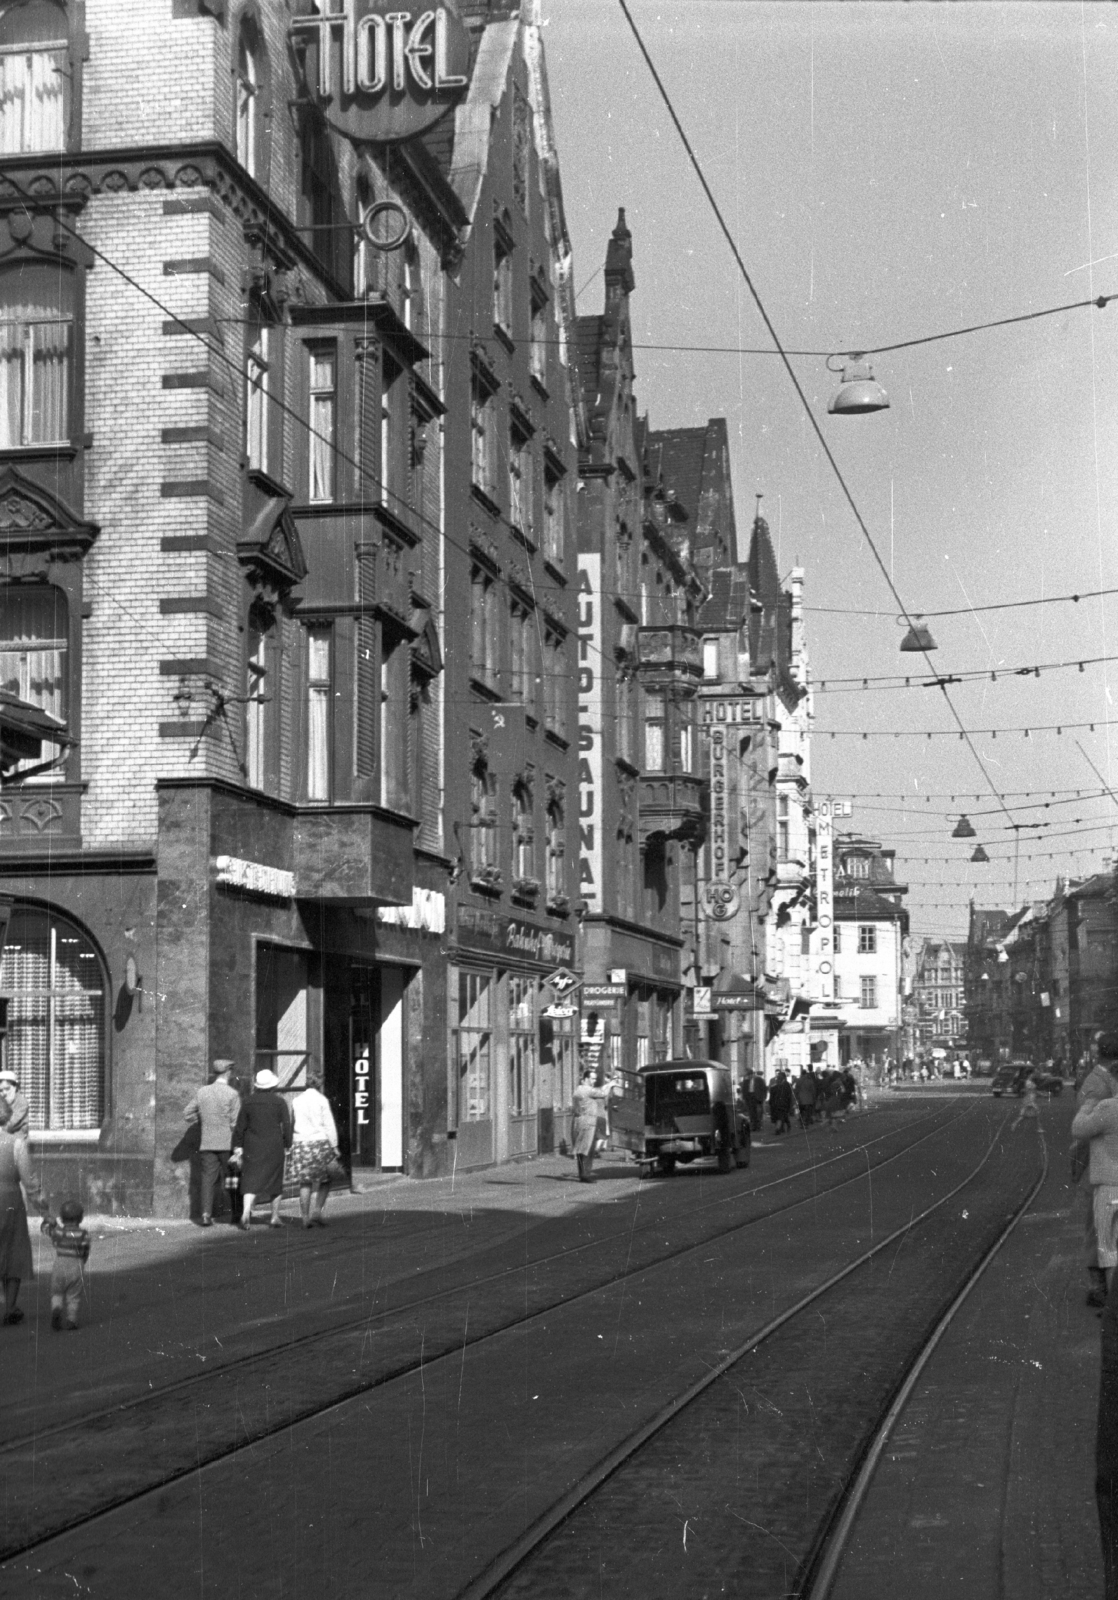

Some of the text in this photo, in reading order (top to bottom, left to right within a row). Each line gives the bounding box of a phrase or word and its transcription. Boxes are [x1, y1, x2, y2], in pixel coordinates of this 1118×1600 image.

[291, 0, 468, 97] HOTEL
[702, 700, 763, 723] HOTEL
[813, 801, 850, 817] HOTEL
[818, 822, 833, 998] METROPOL
[549, 976, 574, 990] Agfa
[583, 986, 625, 995] DROGERIE
[354, 1042, 370, 1125] HOTEL
